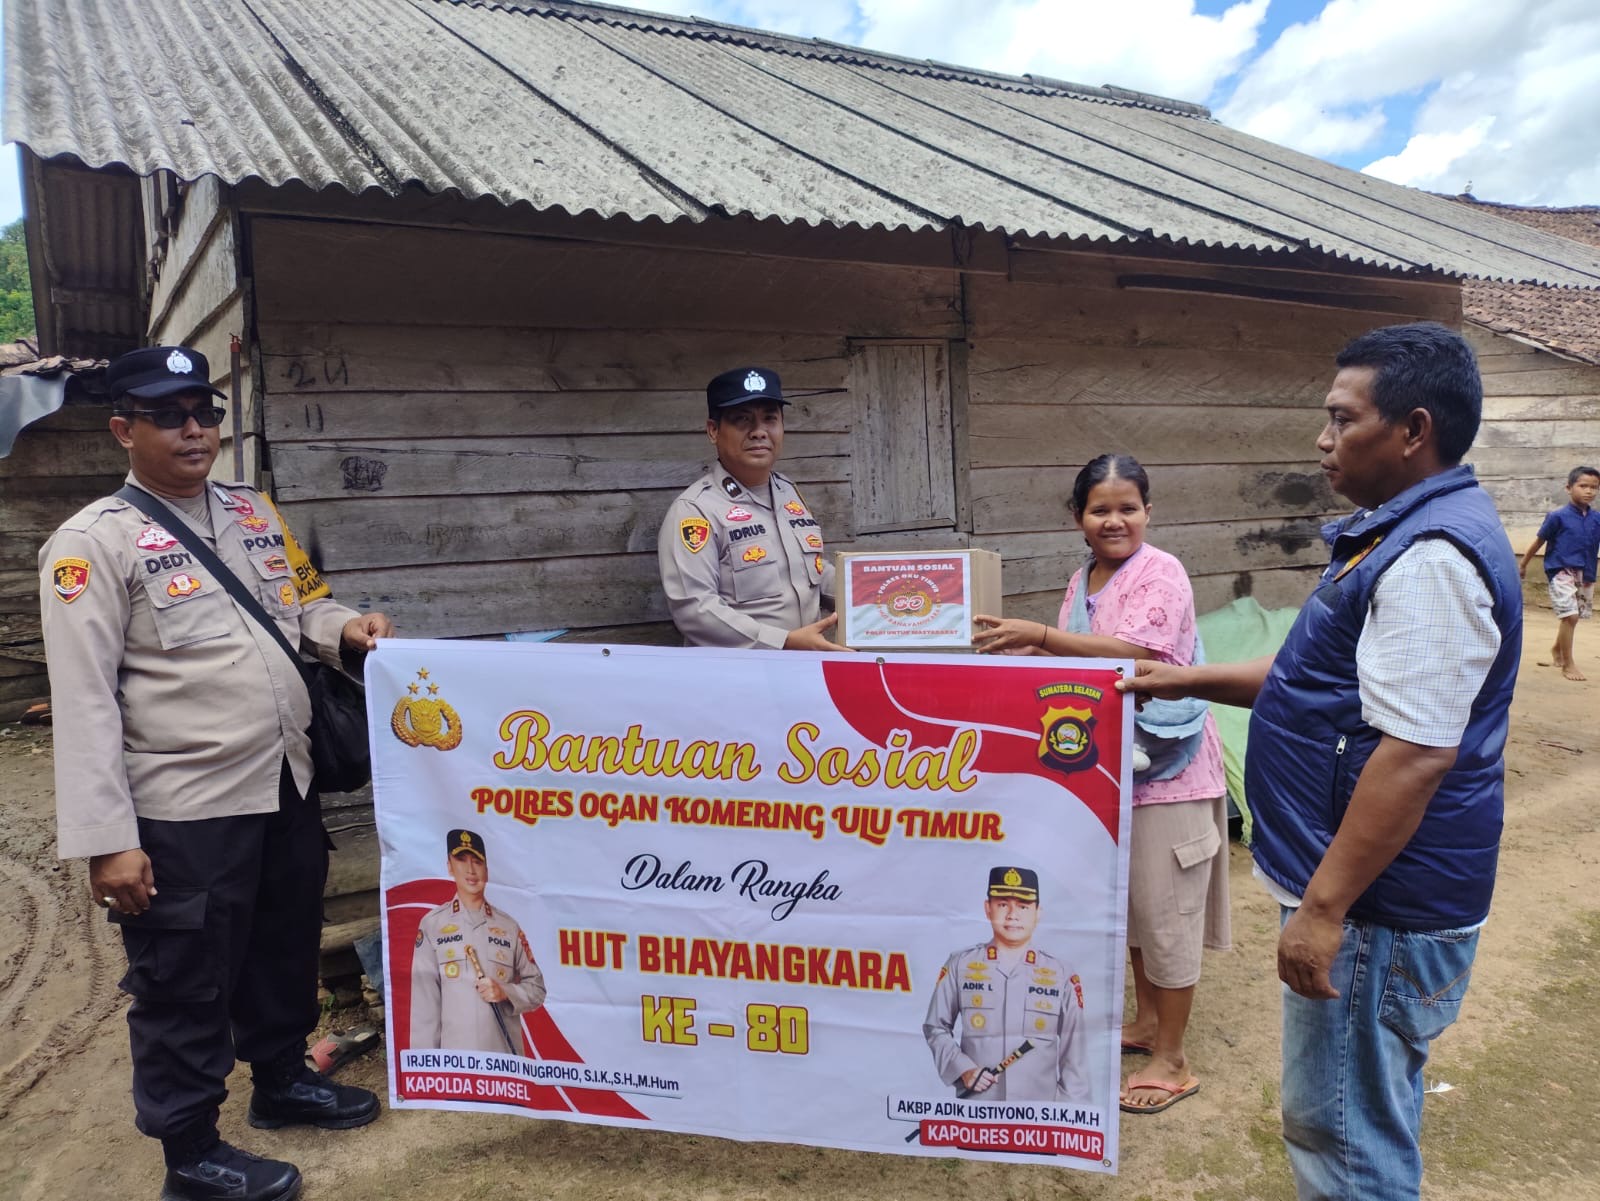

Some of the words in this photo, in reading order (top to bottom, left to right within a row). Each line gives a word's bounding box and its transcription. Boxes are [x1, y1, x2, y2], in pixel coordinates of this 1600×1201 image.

[243, 534, 286, 551] POLRI
[728, 524, 766, 541] IDRUS
[145, 553, 193, 574] DEDY
[863, 565, 915, 573] BANTUAN
[917, 563, 955, 571] SOSIAL
[1039, 684, 1073, 697] SUMATERA
[1073, 685, 1102, 700] SELATAN
[493, 710, 761, 781] Bantuan
[778, 722, 978, 792] Sosial
[471, 788, 574, 826] POLRES
[579, 793, 658, 828] OGAN
[664, 798, 825, 840] KOMERING
[831, 805, 892, 845] ULU
[896, 809, 1005, 842] TIMUR
[620, 853, 726, 893] Dalam
[731, 859, 843, 922] Rangka
[488, 936, 511, 948] POLRI
[558, 928, 628, 970] HUT
[638, 934, 913, 993] BHAYANGKARA
[962, 982, 984, 991] ADIK
[1028, 986, 1060, 997] POLRI
[640, 994, 698, 1046] KE
[746, 1003, 809, 1055] 80
[406, 1055, 440, 1067] IRJEN
[443, 1055, 465, 1069] POL
[467, 1056, 483, 1070] Dr.
[486, 1058, 520, 1074] SANDI
[522, 1062, 582, 1083] NUGROHO,
[405, 1076, 473, 1094] KAPOLDA
[476, 1079, 532, 1101] SUMSEL
[897, 1100, 932, 1115] AKBP
[935, 1102, 965, 1118] ADIK
[968, 1105, 1039, 1122] LISTIYONO,
[927, 1124, 1010, 1145] KAPOLRES
[1013, 1128, 1048, 1148] OKU
[1051, 1131, 1102, 1154] TIMUR
